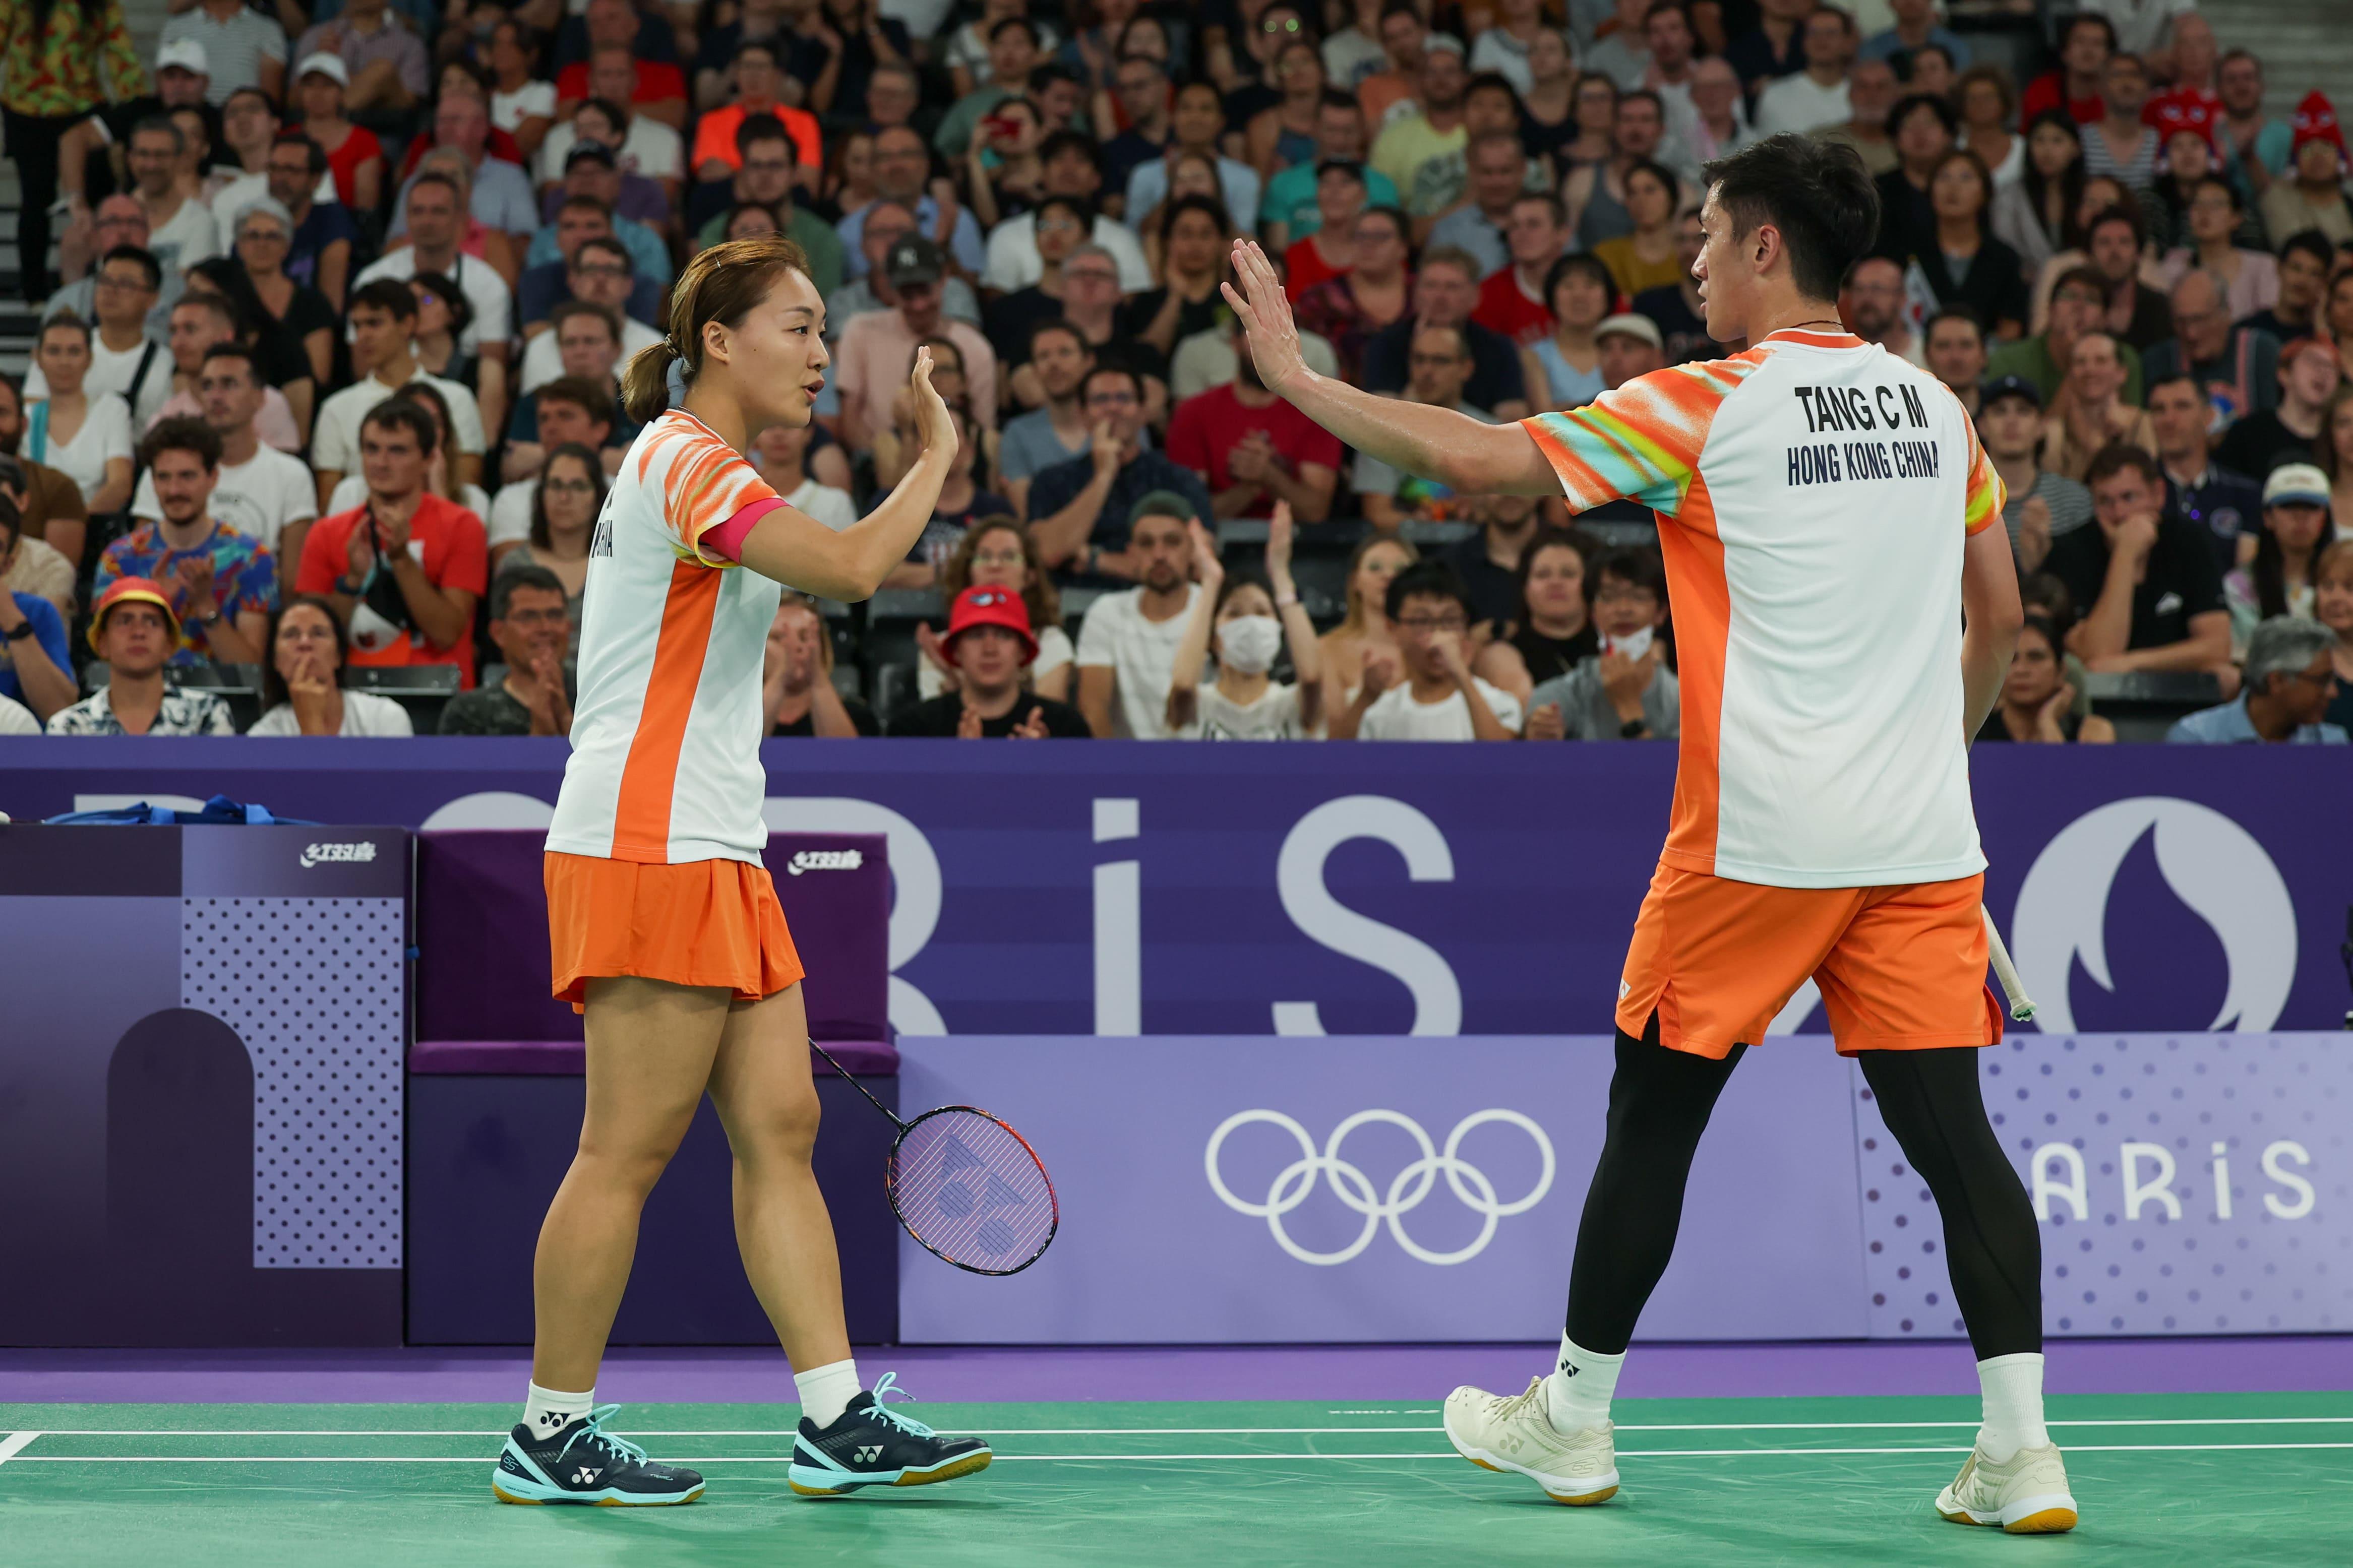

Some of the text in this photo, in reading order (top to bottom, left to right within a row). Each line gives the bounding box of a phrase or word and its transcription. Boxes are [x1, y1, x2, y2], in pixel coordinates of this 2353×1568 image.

[1794, 384, 1928, 432] TANG C M
[1787, 441, 1940, 486] HONG KONG CHINA
[503, 1456, 519, 1471] 65
[1572, 1461, 1596, 1475] 65
